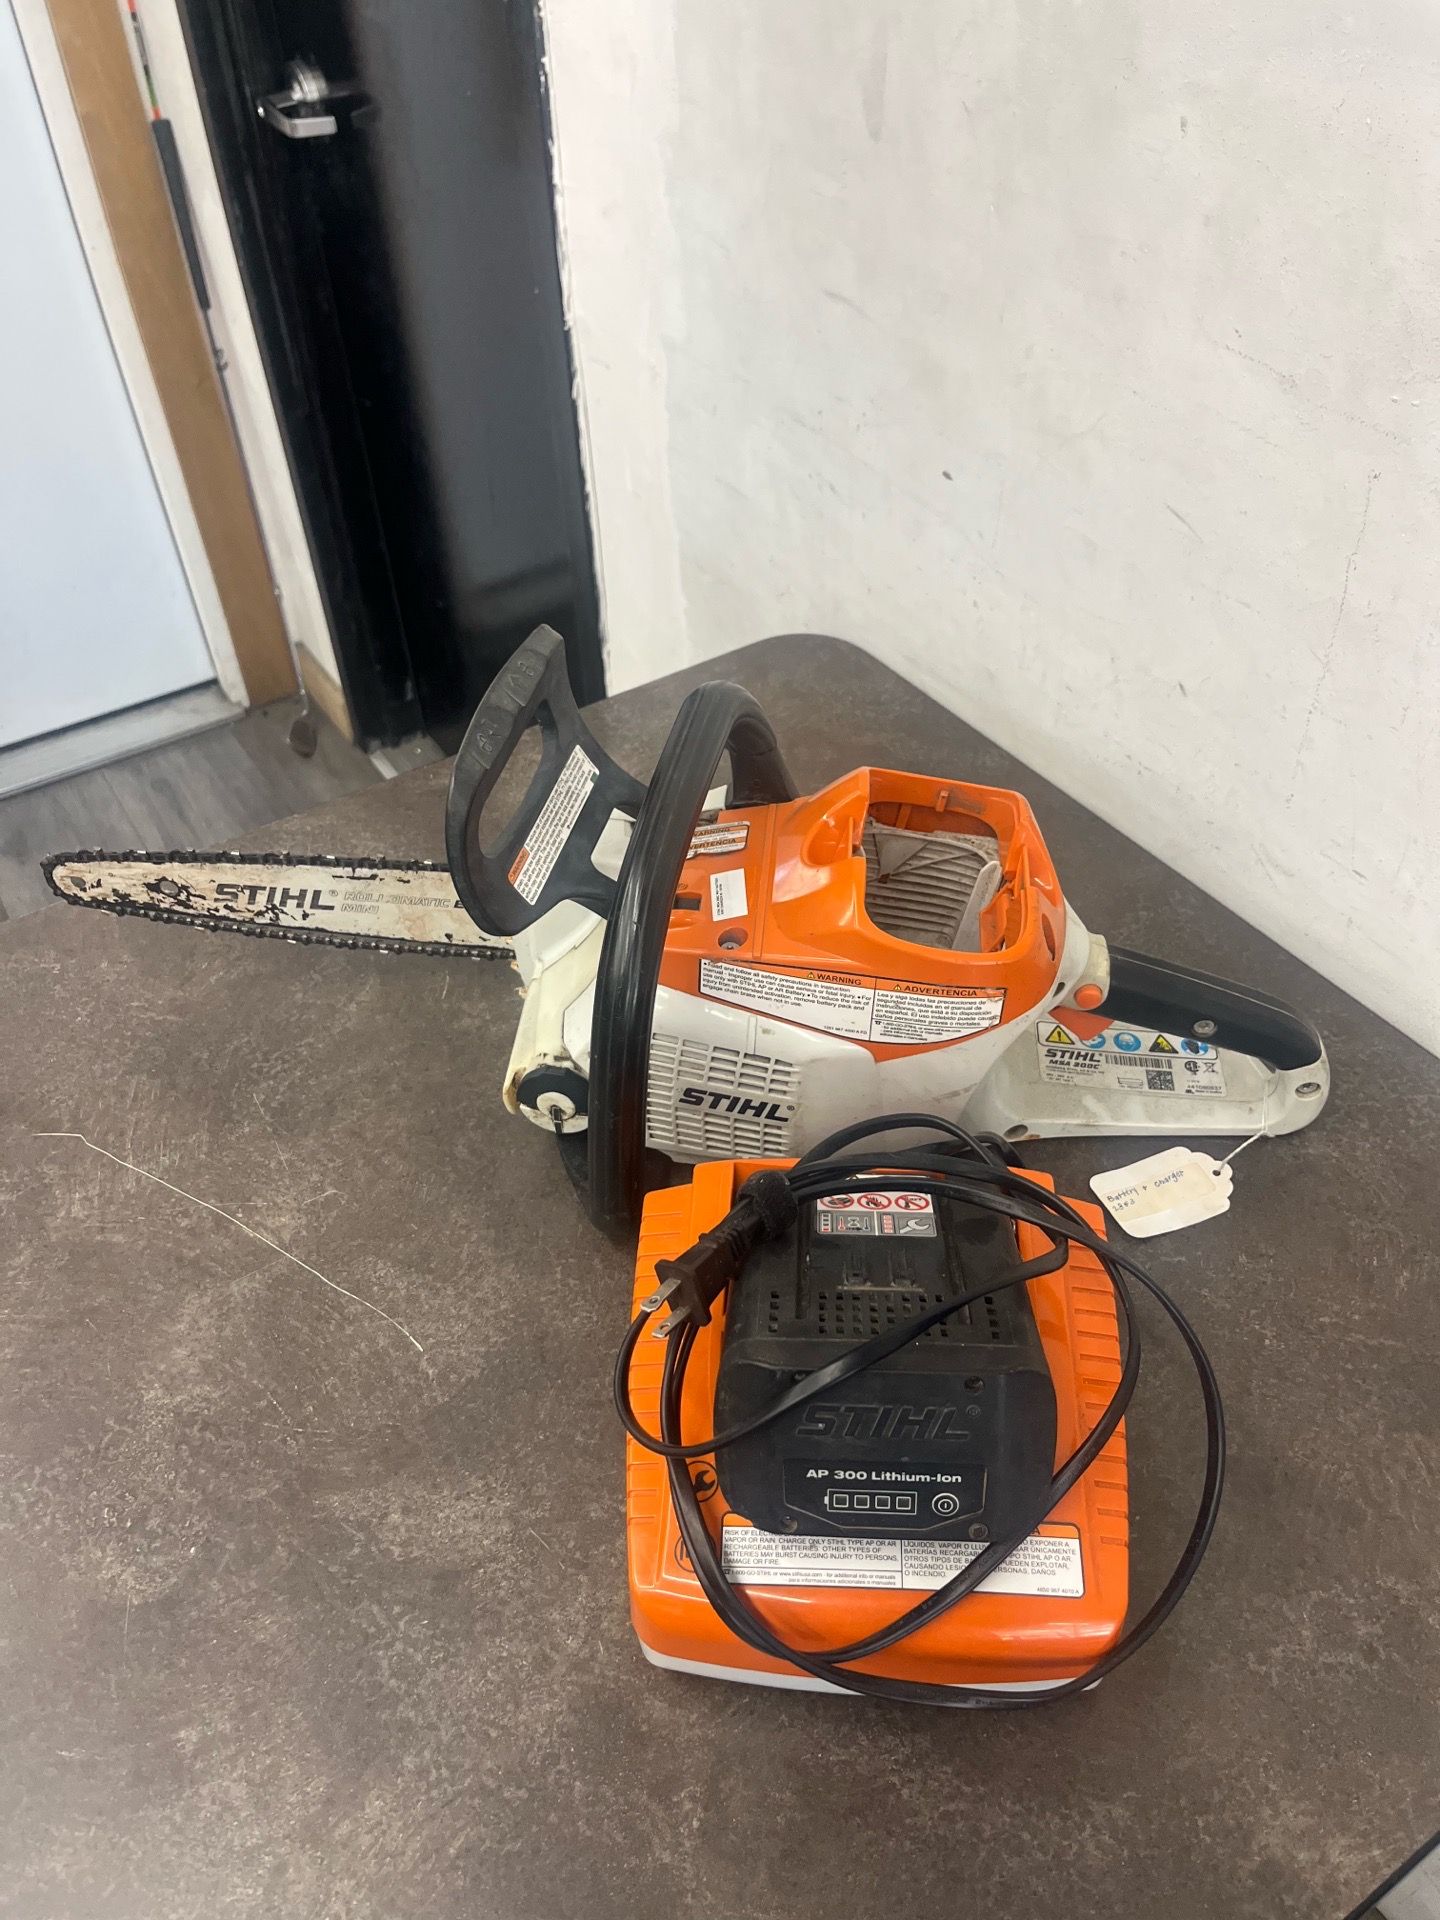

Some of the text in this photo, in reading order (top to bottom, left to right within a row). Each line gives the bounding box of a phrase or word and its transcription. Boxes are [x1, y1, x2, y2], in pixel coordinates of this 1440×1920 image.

[214, 884, 335, 911] STIHL
[817, 973, 862, 985] WARNING
[904, 985, 978, 997] ADVERTENCIA
[1045, 1048, 1101, 1063] STIHL
[678, 1087, 790, 1123] STIHL
[796, 1403, 970, 1442] STIHL
[806, 1469, 962, 1483] AP 300 Lithium-Ion
